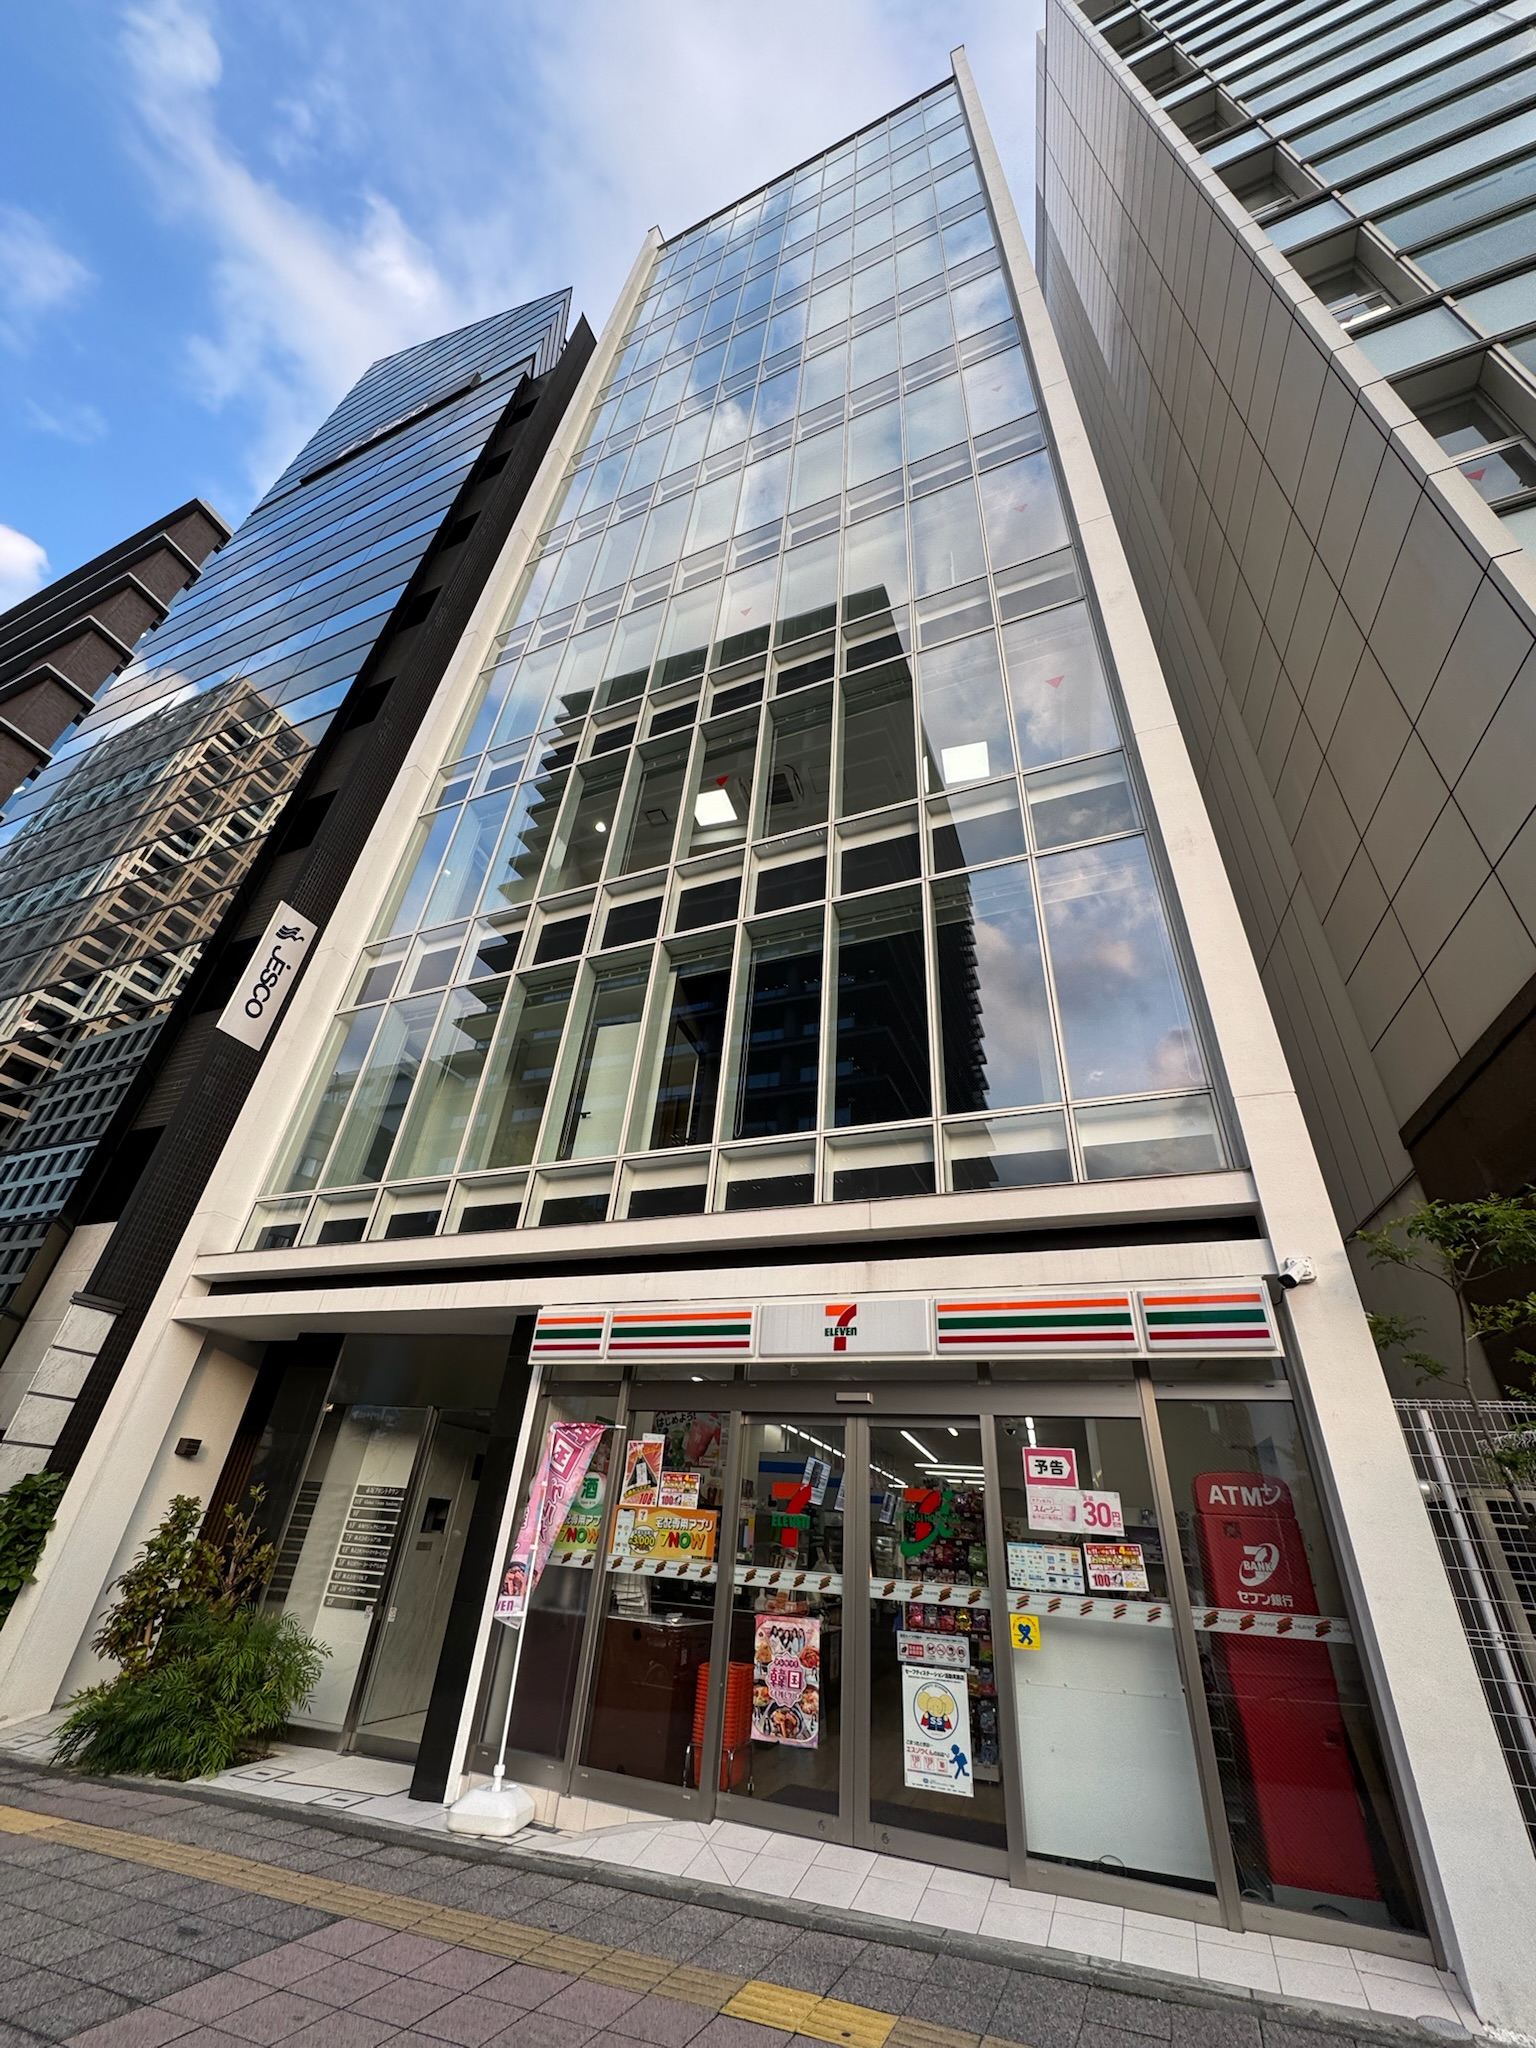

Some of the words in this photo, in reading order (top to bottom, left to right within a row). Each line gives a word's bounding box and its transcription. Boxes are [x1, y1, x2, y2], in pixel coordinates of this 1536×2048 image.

[825, 1303, 858, 1351] 7
[1034, 1459, 1064, 1476] 予告
[580, 1477, 600, 1499] 酒
[655, 1516, 714, 1532] 宅配専用アプリ
[660, 1530, 706, 1550] 7NOW
[1243, 1560, 1273, 1573] BANK
[1092, 1574, 1111, 1587] 100
[1237, 1590, 1294, 1608] セブン銀行
[769, 1668, 802, 1690] 韓国
[929, 1716, 943, 1726] SS
